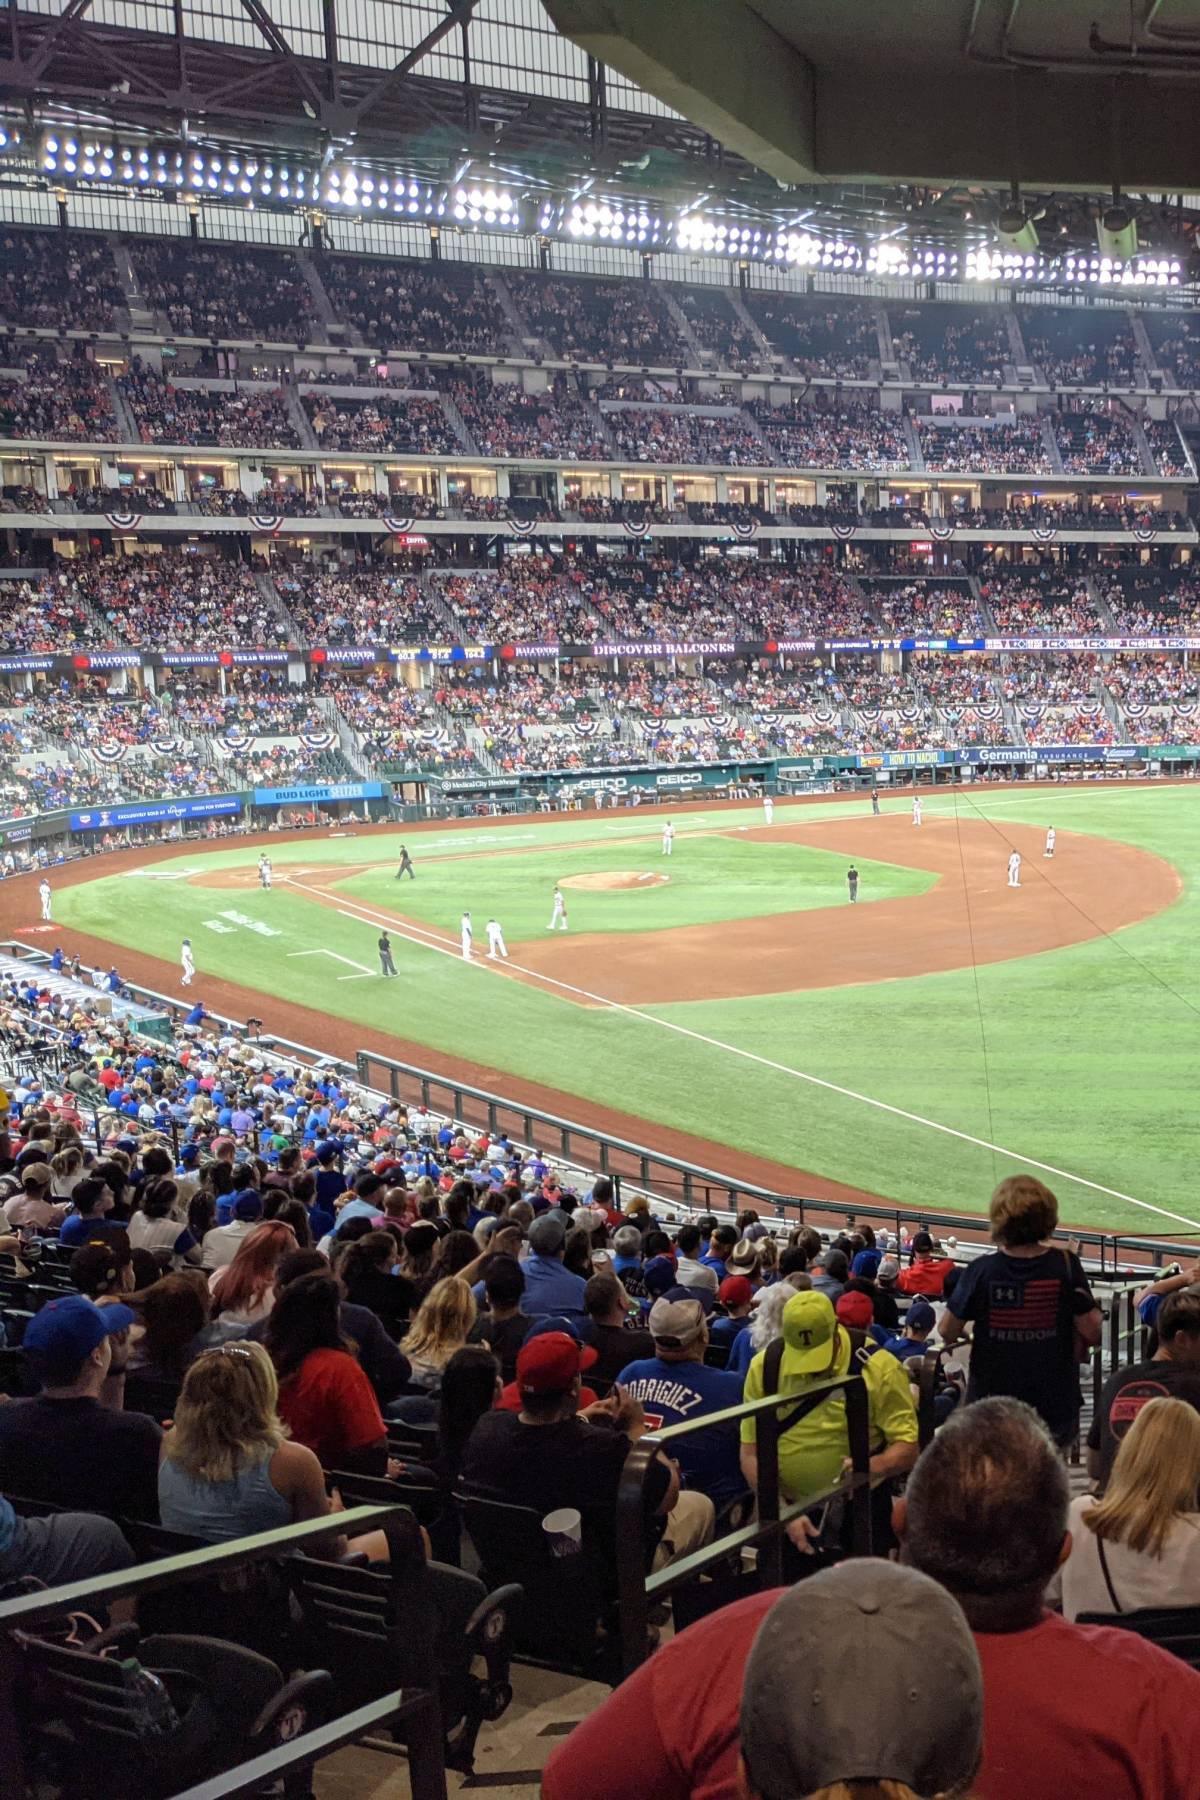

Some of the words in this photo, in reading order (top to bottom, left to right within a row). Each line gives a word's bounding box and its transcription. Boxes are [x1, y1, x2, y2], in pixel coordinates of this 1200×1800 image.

[593, 645, 661, 656] DISCOVER
[665, 643, 735, 654] BALCONES
[980, 750, 1038, 761] Germania
[579, 778, 626, 789] GEICO
[656, 774, 701, 785] GEICO
[276, 791, 298, 799] BUD
[300, 789, 328, 798] LIGHT
[799, 1330, 813, 1345] T
[989, 1329, 1057, 1341] FREEDOM
